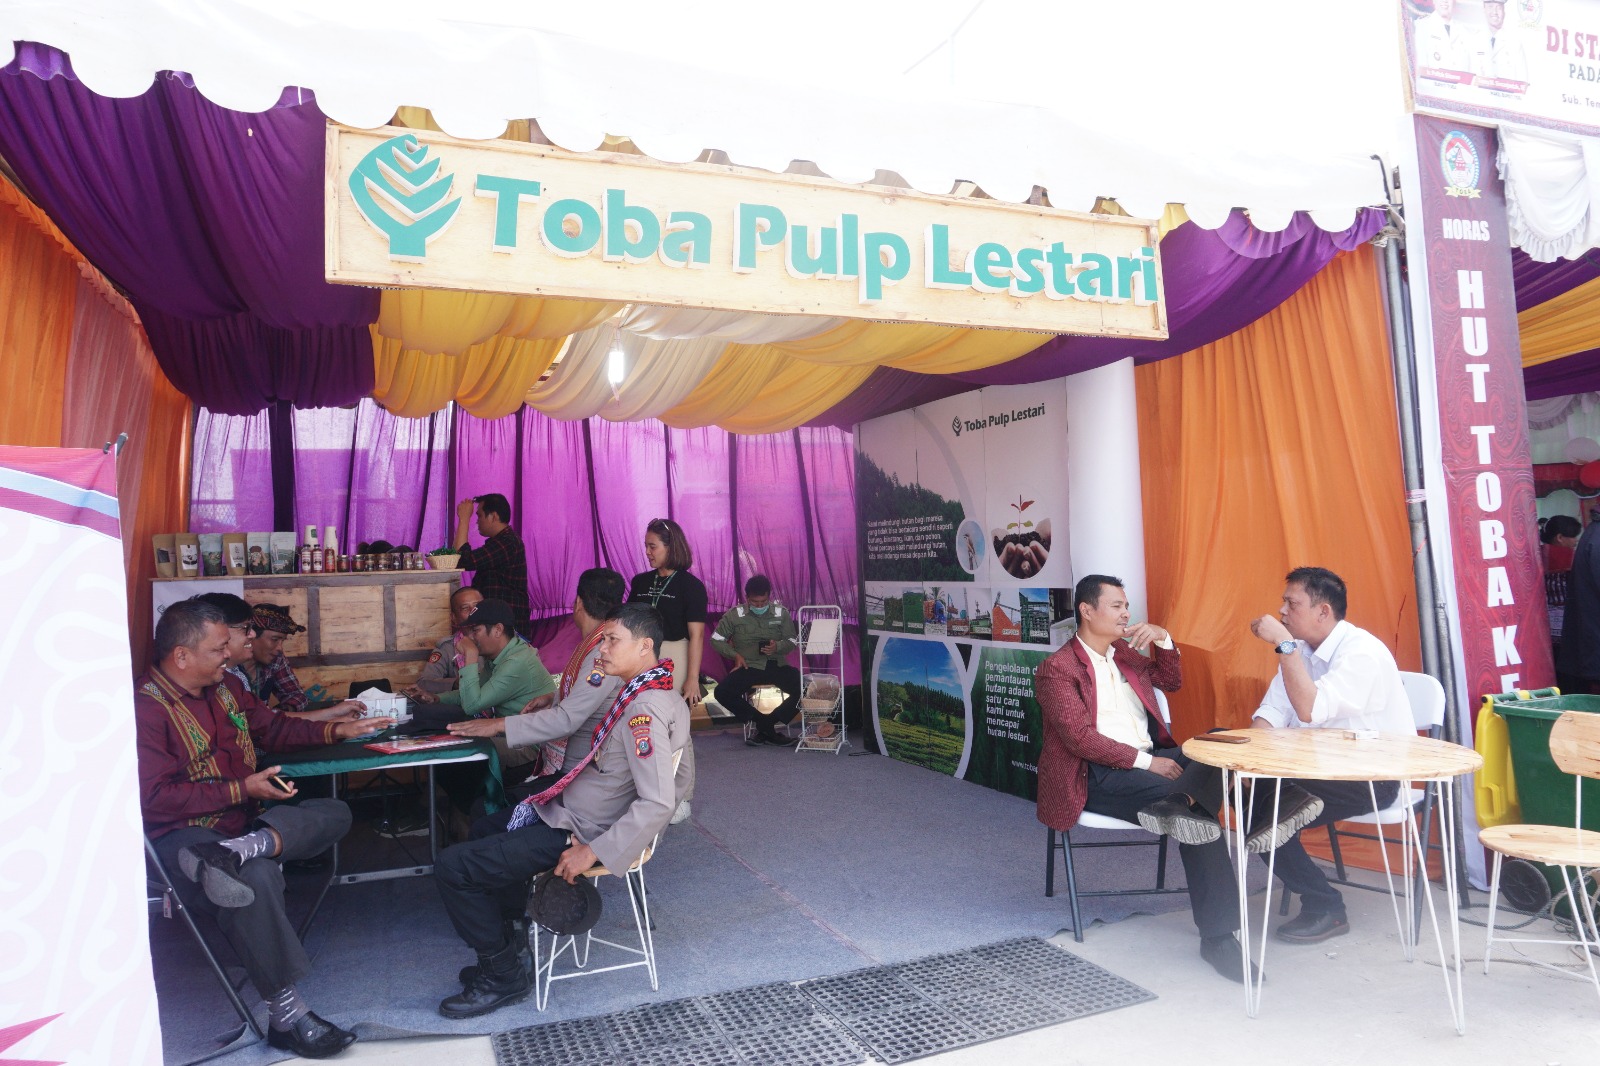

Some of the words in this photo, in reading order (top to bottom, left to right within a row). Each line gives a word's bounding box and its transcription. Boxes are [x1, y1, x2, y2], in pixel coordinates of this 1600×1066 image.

[1546, 25, 1568, 55] DI
[1574, 31, 1600, 61] ST
[1562, 93, 1582, 106] Sub.
[1442, 218, 1490, 241] HORAS
[474, 173, 712, 268] Toba
[733, 202, 911, 305] Pulp
[923, 223, 1159, 307] Lestari
[1457, 270, 1490, 403] HUT
[964, 419, 986, 432] Toba
[989, 414, 1009, 427] Pulp
[1012, 403, 1045, 422] Lestari
[1470, 425, 1514, 608] TOBA
[985, 661, 1030, 674] Pengelolaan
[985, 674, 1031, 686] pemantauan
[986, 682, 1006, 693] hutan
[1008, 686, 1034, 698] adalah
[986, 695, 1001, 704] satu
[1004, 697, 1019, 707] cara
[986, 704, 1004, 715] kami
[1006, 710, 1025, 719] untuk
[987, 717, 1019, 729] mencapai
[988, 727, 1006, 738] hutan
[1008, 730, 1030, 743] lestari.
[1012, 760, 1038, 774] www.tobap
